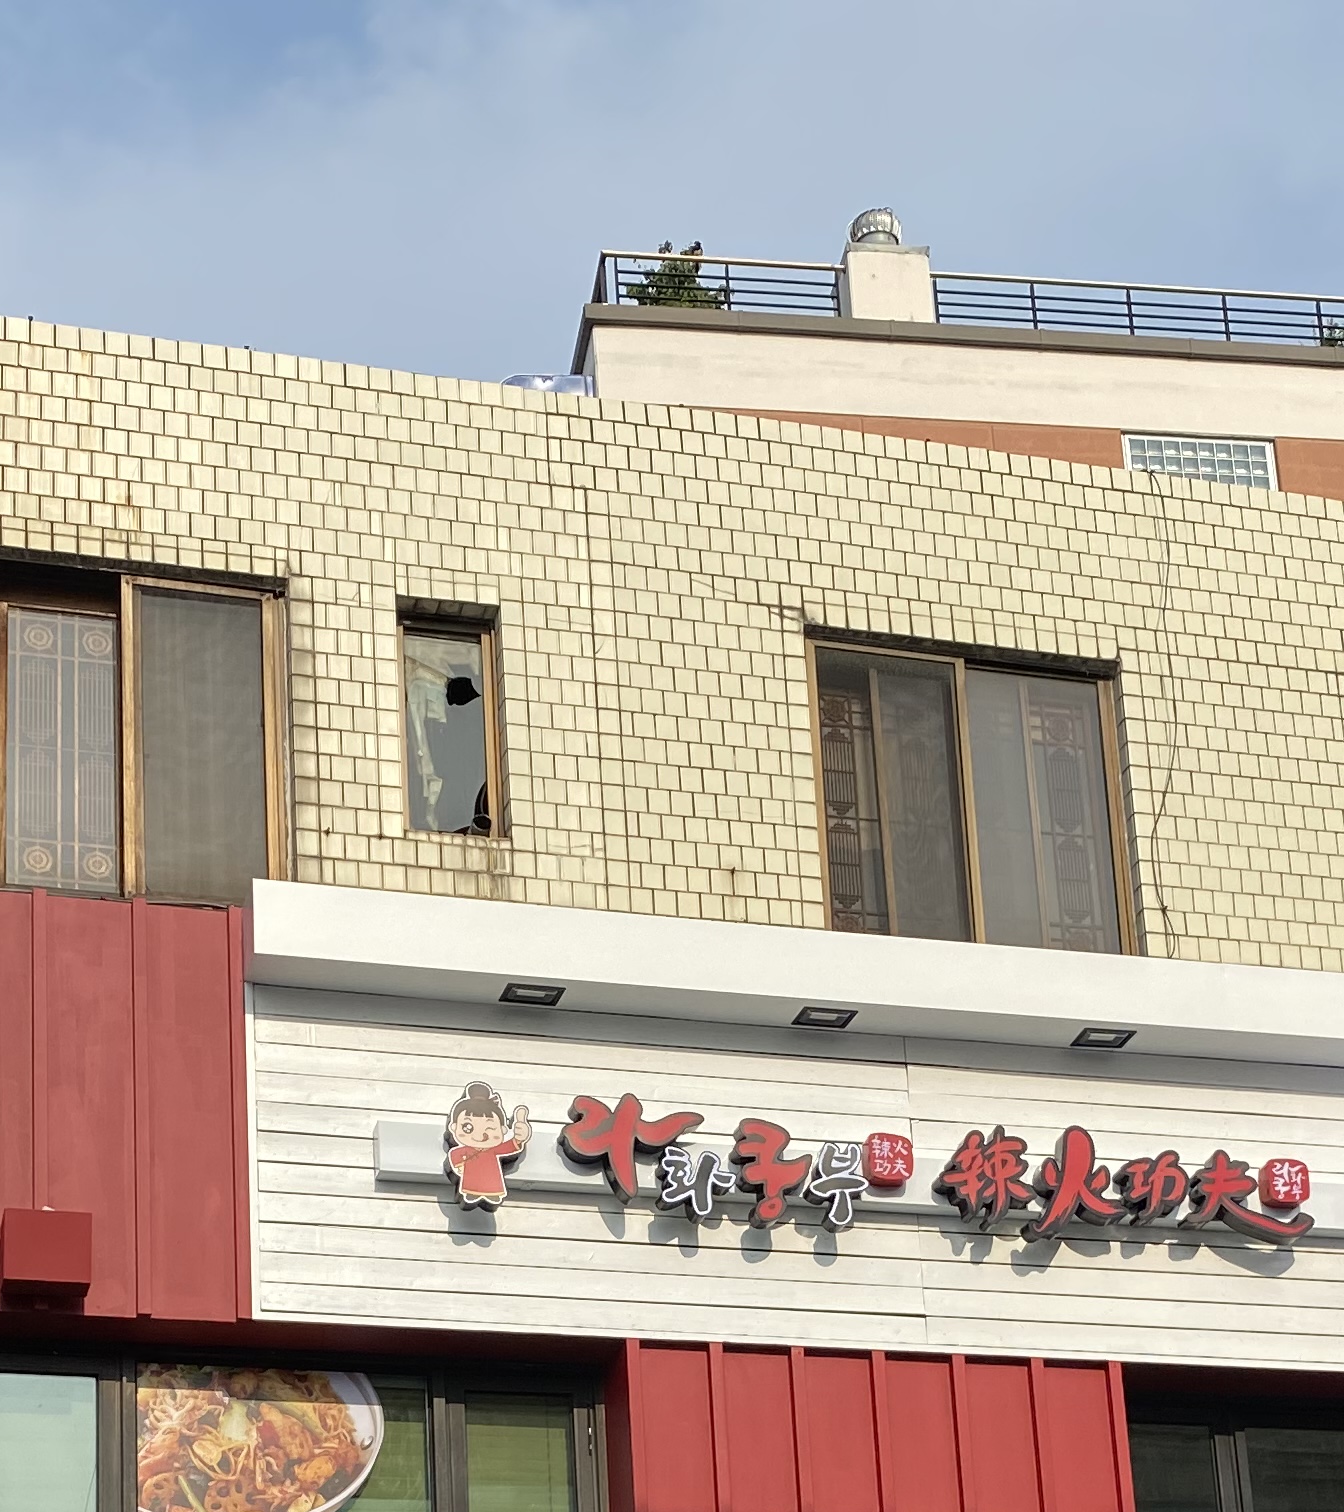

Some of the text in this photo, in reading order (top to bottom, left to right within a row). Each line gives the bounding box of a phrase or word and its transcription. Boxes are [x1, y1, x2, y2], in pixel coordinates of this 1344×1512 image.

[563, 1093, 868, 1226] 라화쿵부
[936, 1125, 1315, 1245] 辣火功夫
